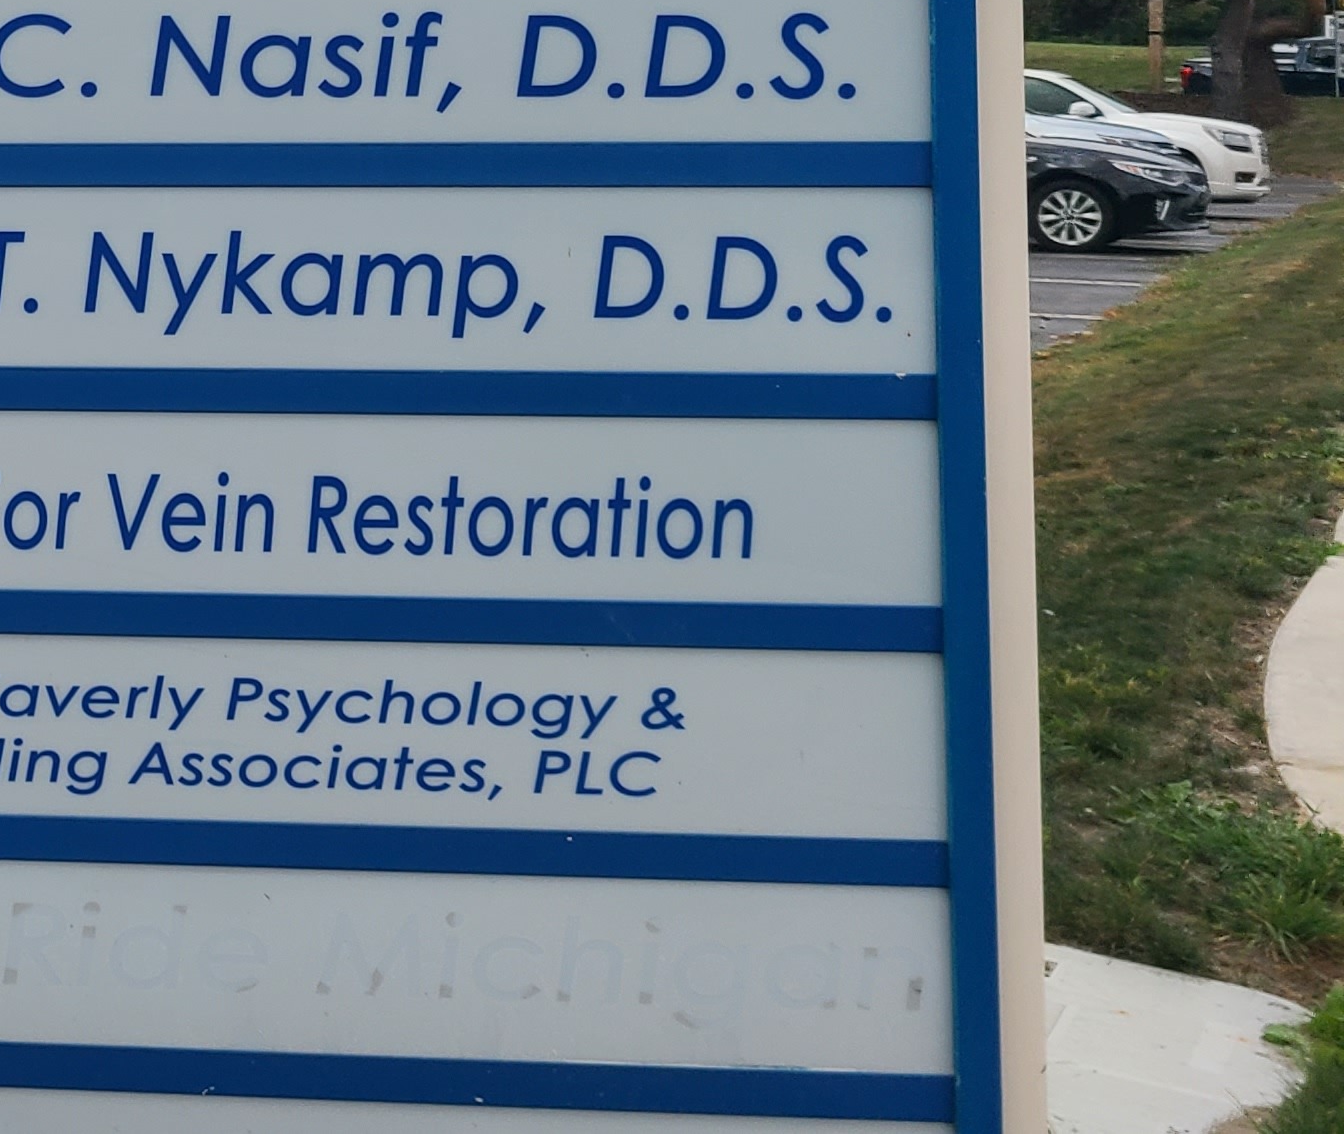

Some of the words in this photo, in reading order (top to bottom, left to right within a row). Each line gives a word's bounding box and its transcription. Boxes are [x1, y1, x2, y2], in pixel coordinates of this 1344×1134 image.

[149, 10, 463, 115] Nasif,
[515, 11, 857, 101] D.D.S.
[83, 229, 547, 340] Nykamp,
[592, 234, 893, 324] D.D.S.
[106, 470, 275, 554] Vein
[306, 474, 755, 561] Restoration
[225, 676, 619, 741] Psychology
[640, 686, 687, 731] &
[127, 741, 504, 802] Associates,
[532, 749, 662, 799] PLC
